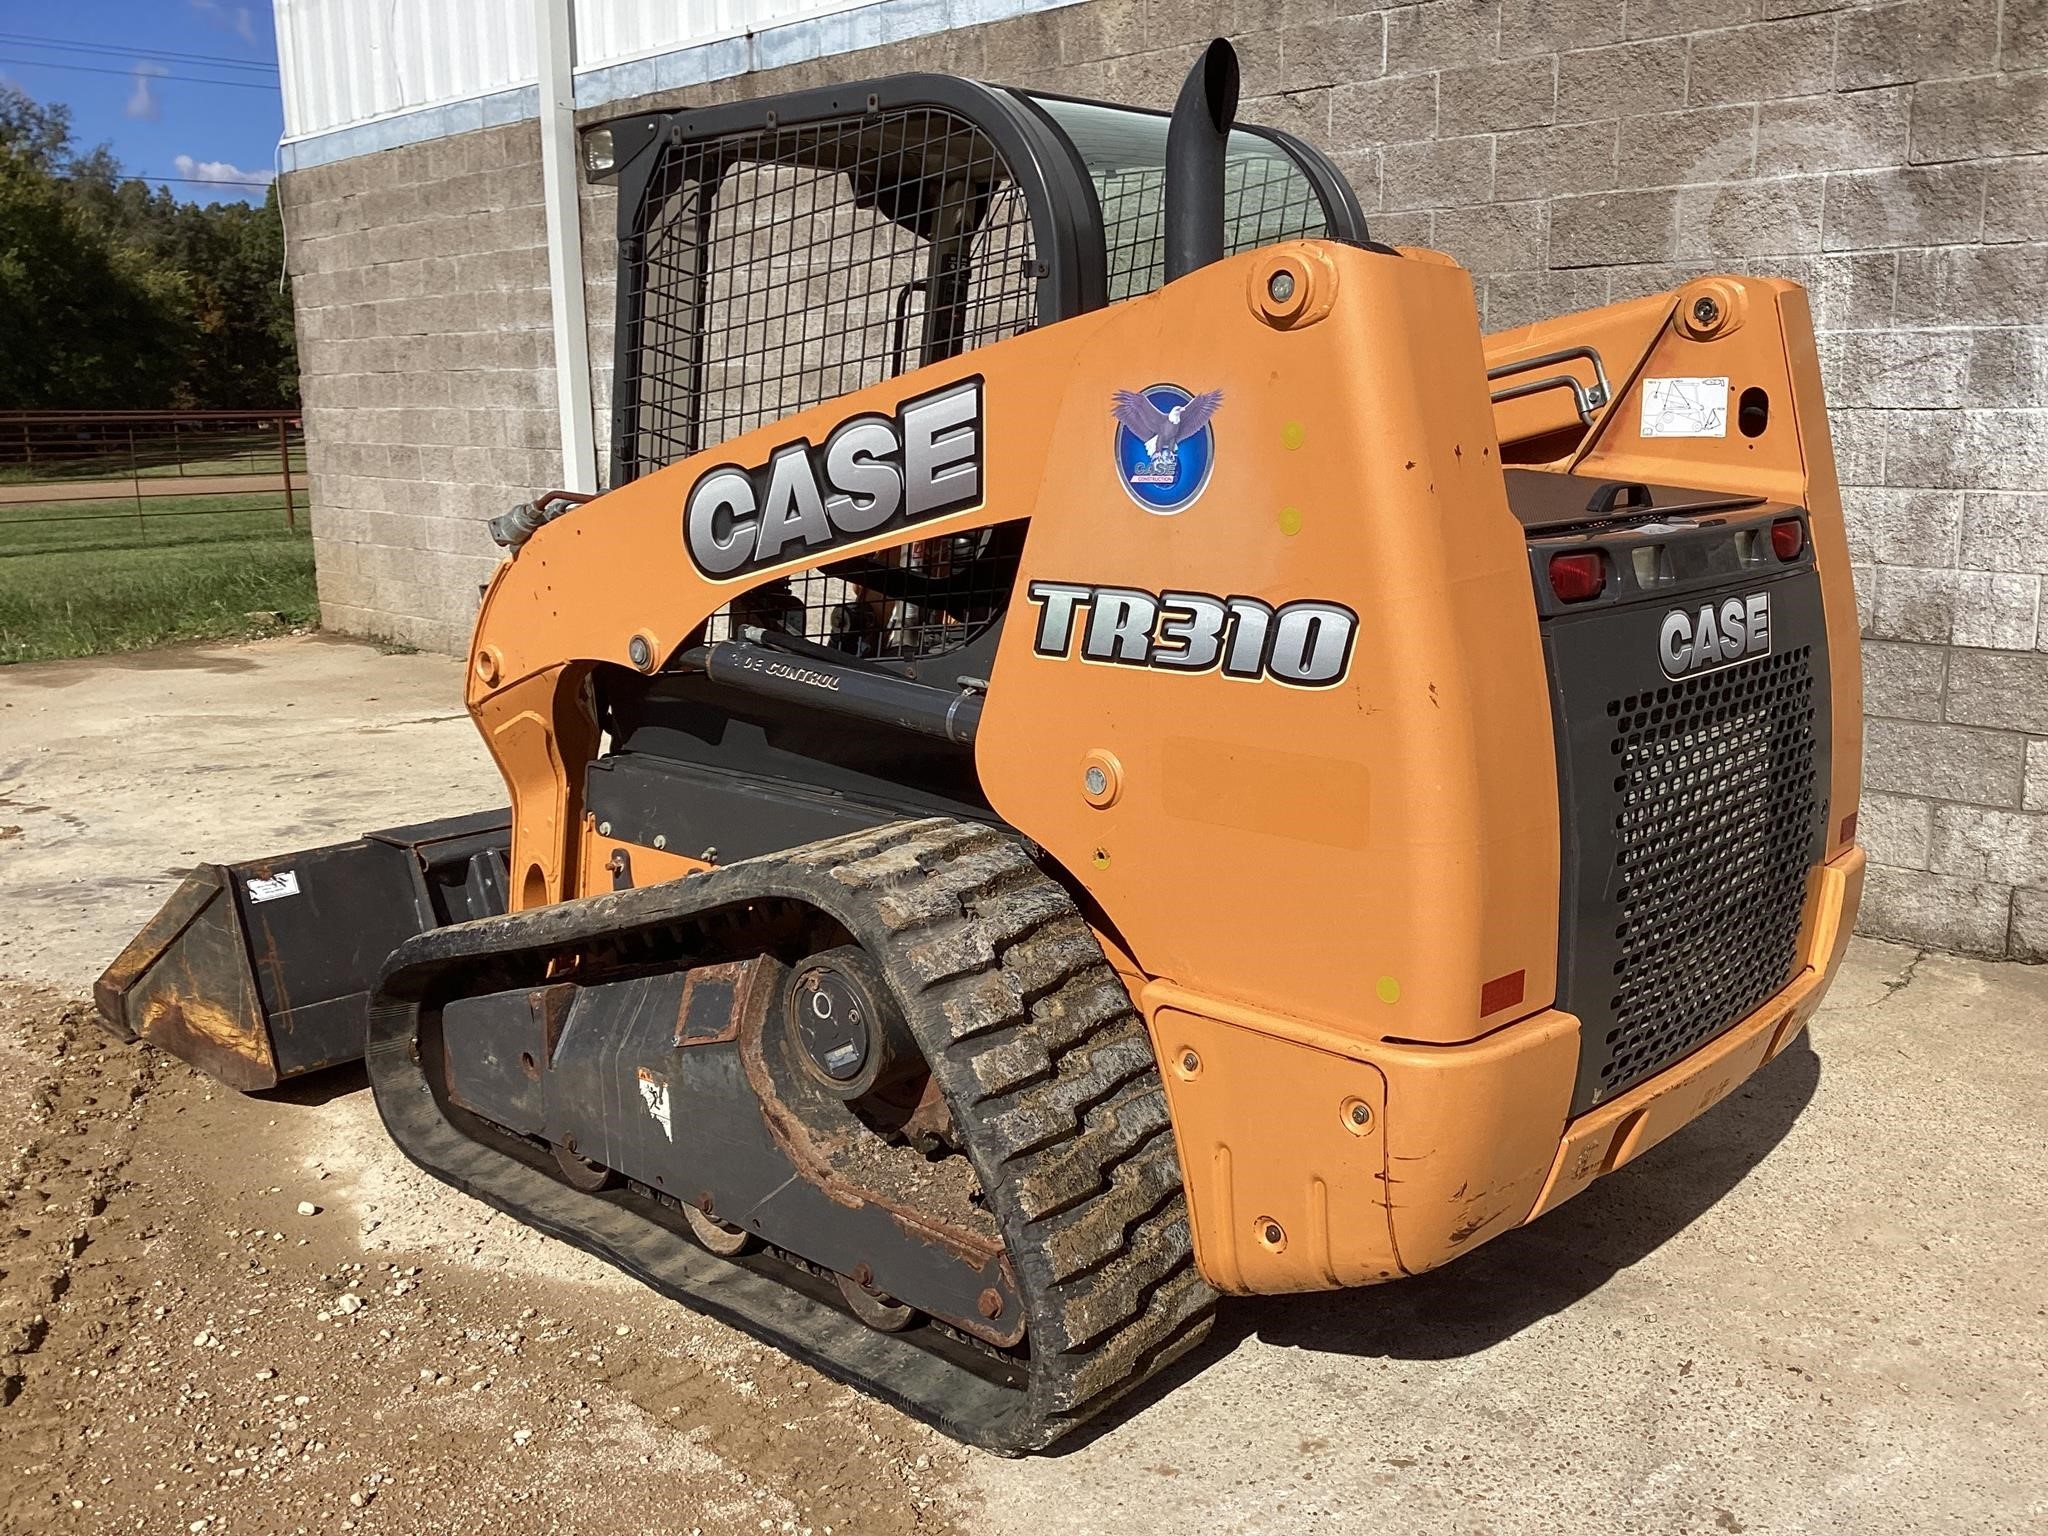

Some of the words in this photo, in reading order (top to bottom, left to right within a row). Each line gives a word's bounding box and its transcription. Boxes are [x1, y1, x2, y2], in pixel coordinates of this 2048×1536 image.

[686, 376, 982, 577] CASE
[765, 662, 840, 691] CONTROL
[1029, 581, 1359, 687] TR310
[1659, 591, 1769, 678] CASE
